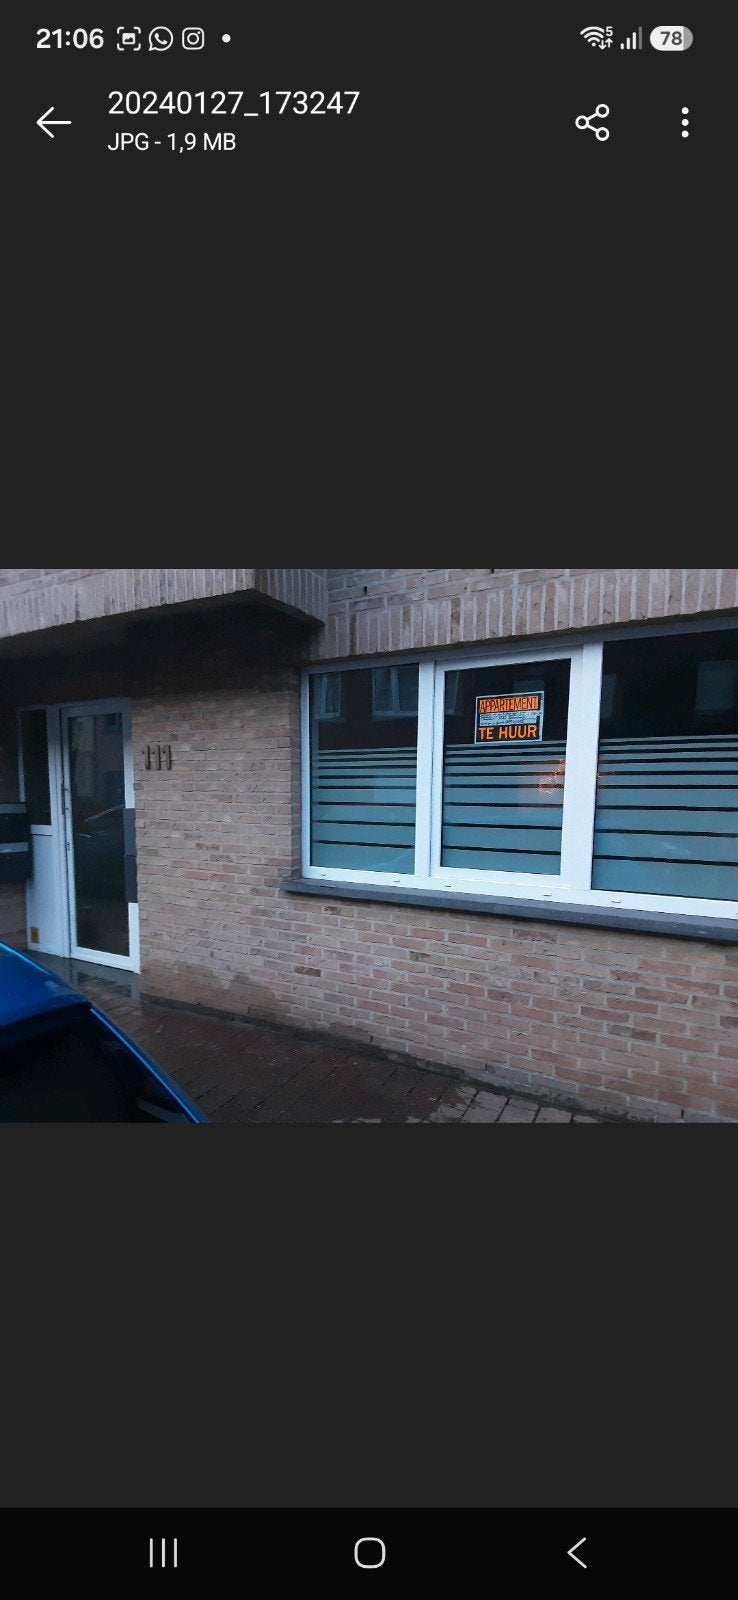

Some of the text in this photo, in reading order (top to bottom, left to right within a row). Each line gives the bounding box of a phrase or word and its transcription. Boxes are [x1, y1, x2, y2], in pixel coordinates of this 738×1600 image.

[480, 696, 539, 712] APPARTEMENT
[478, 725, 537, 740] TE HUUR
[142, 745, 172, 770] 111
